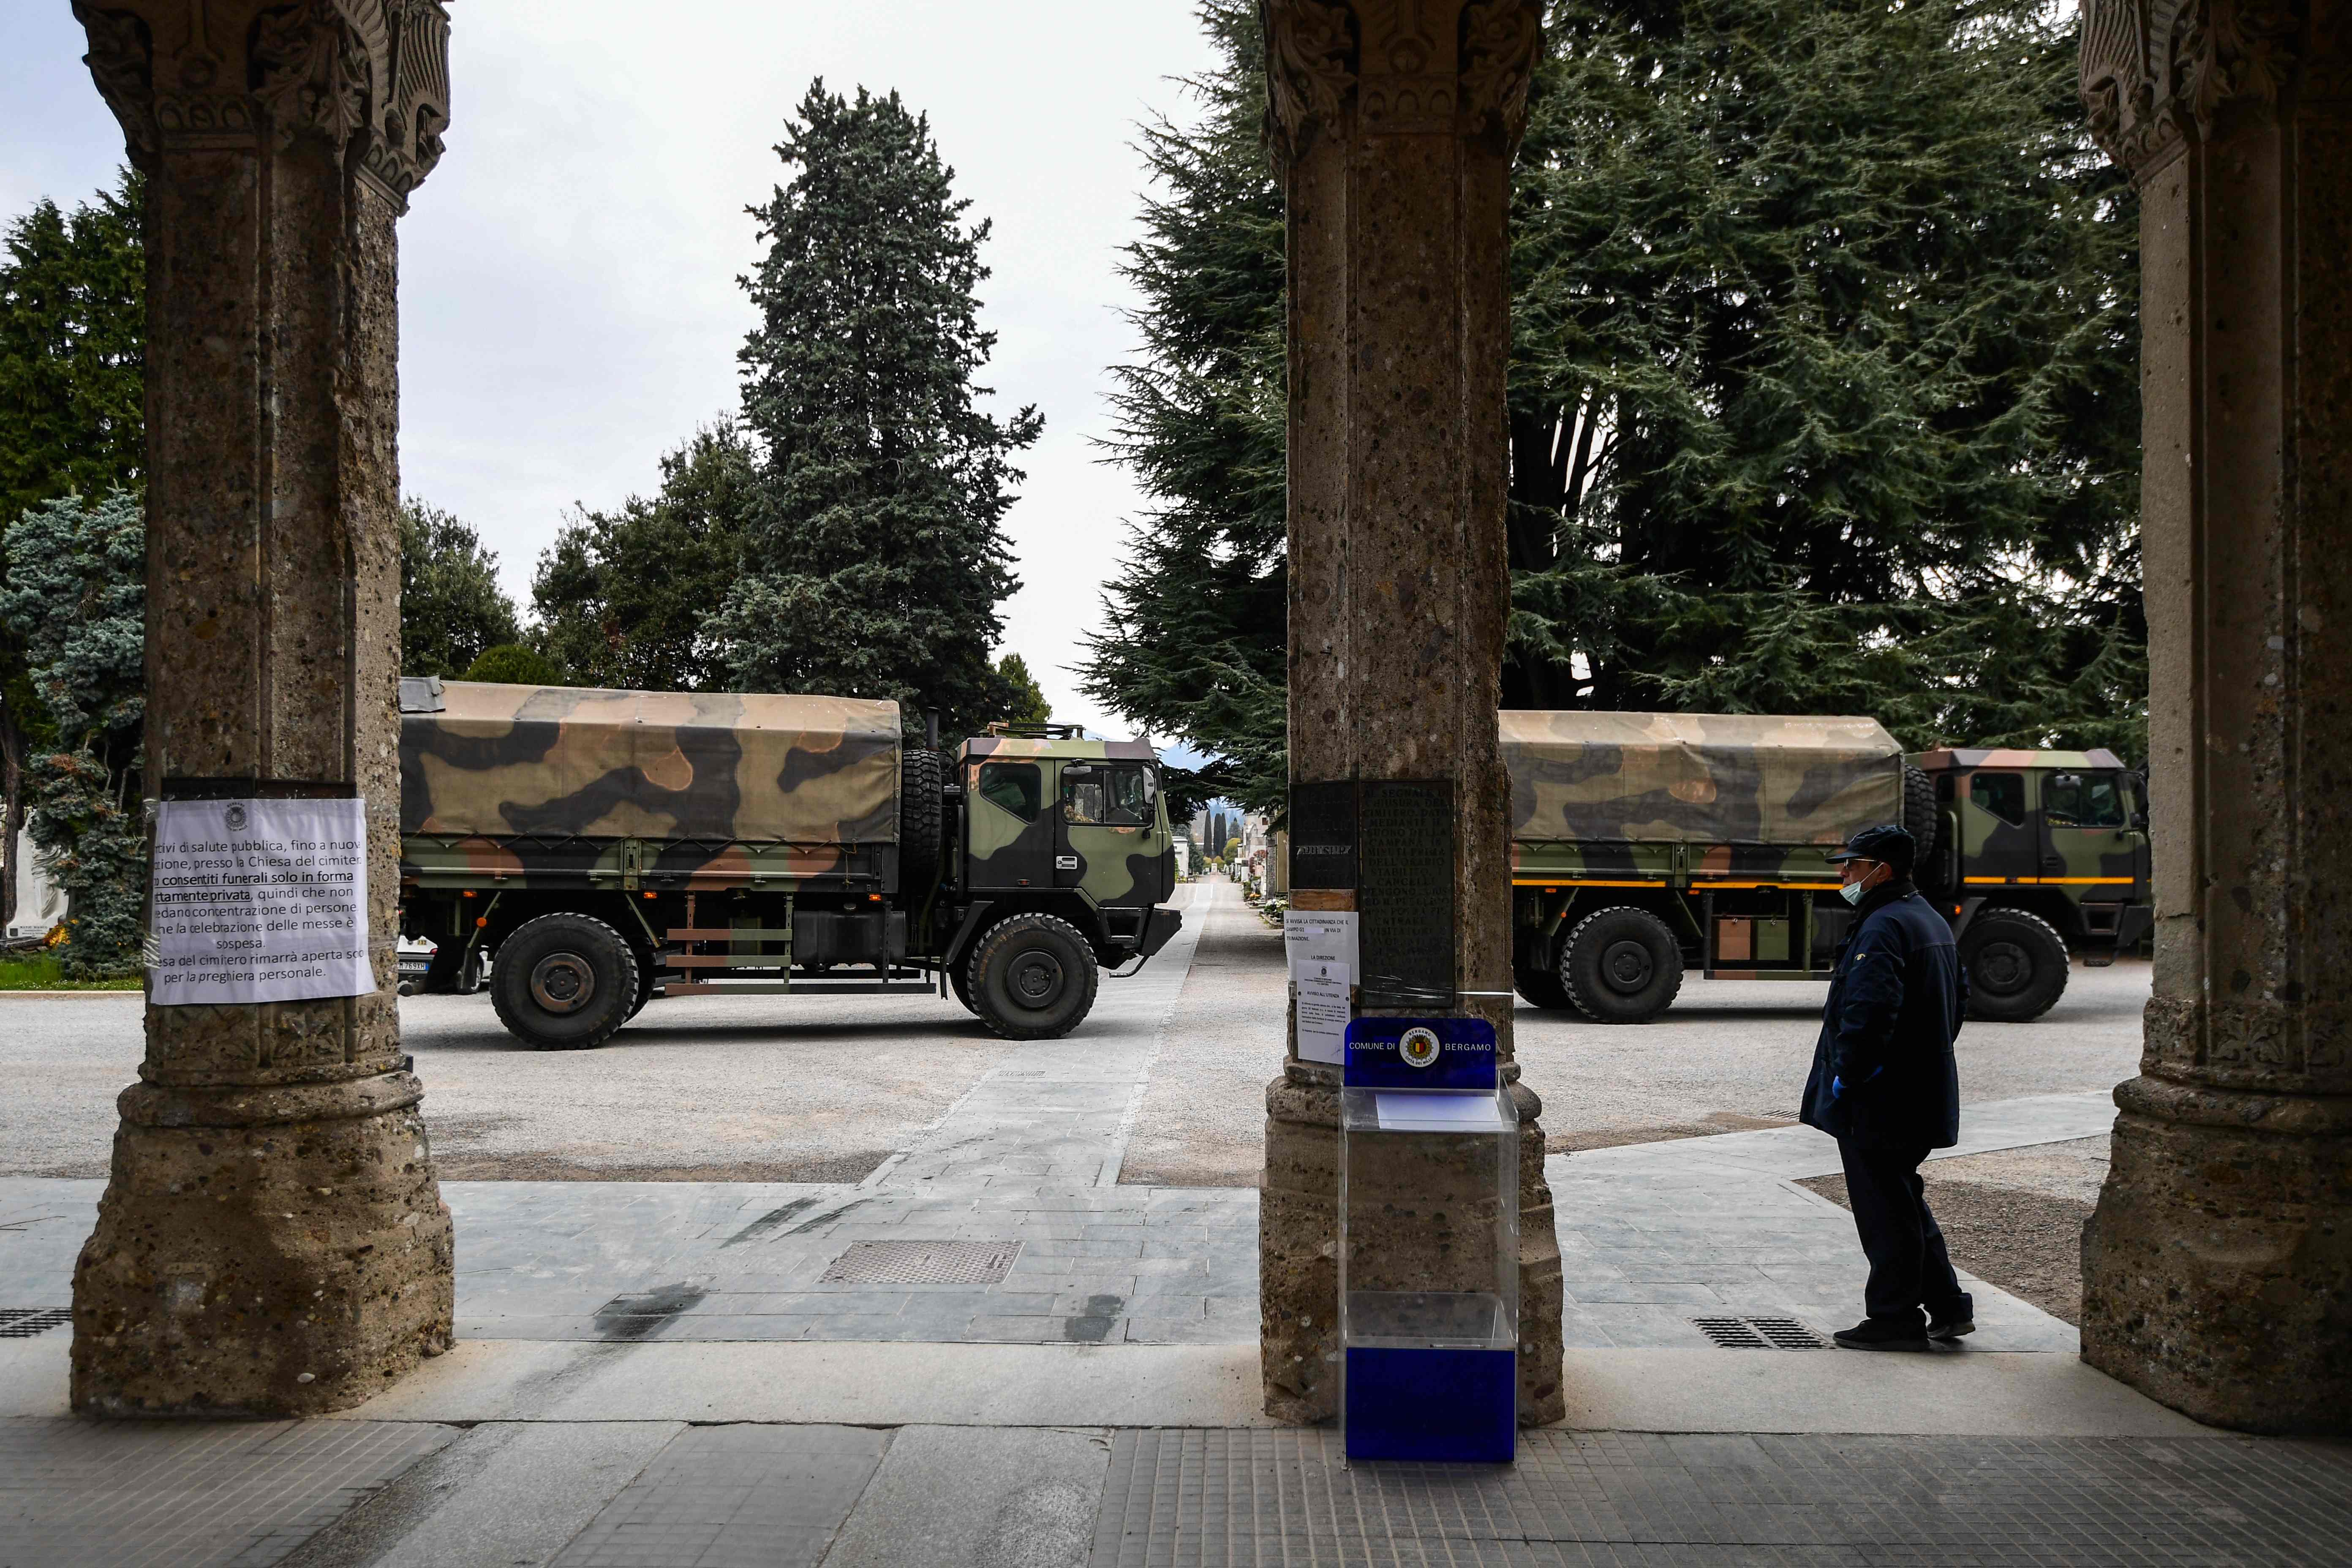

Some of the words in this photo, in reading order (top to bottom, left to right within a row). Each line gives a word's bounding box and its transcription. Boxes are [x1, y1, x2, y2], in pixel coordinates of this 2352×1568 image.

[180, 841, 189, 853] di
[192, 841, 227, 852] salute
[231, 840, 287, 854] pubblica,
[291, 840, 316, 851] fino
[320, 842, 326, 850] a
[194, 859, 232, 871] presso
[237, 857, 244, 867] la
[249, 856, 291, 867] Chiesa
[296, 855, 315, 866] del
[163, 874, 218, 886] consentiti
[223, 872, 267, 884] funerali
[272, 871, 298, 883] solo
[302, 872, 313, 882] in
[318, 871, 353, 882] forma
[211, 890, 253, 902] privata,
[258, 887, 298, 901] quindi
[302, 887, 325, 897] che
[330, 888, 353, 897] non
[193, 905, 286, 917] concentrazione
[291, 904, 302, 914] di
[177, 923, 186, 934] la
[190, 922, 262, 933] celebrazione
[267, 920, 298, 931] delle
[303, 920, 342, 929] messe
[347, 917, 354, 927] è
[217, 940, 265, 950] sospesa.
[179, 955, 196, 966] del
[200, 955, 247, 965] cimitero
[250, 951, 297, 964] rimarrà
[302, 950, 342, 963] aperta
[165, 974, 183, 985] per
[187, 971, 196, 982] la
[199, 970, 254, 983] preghiera
[259, 966, 326, 982] personale.
[1423, 1057, 1433, 1065] MILLE
